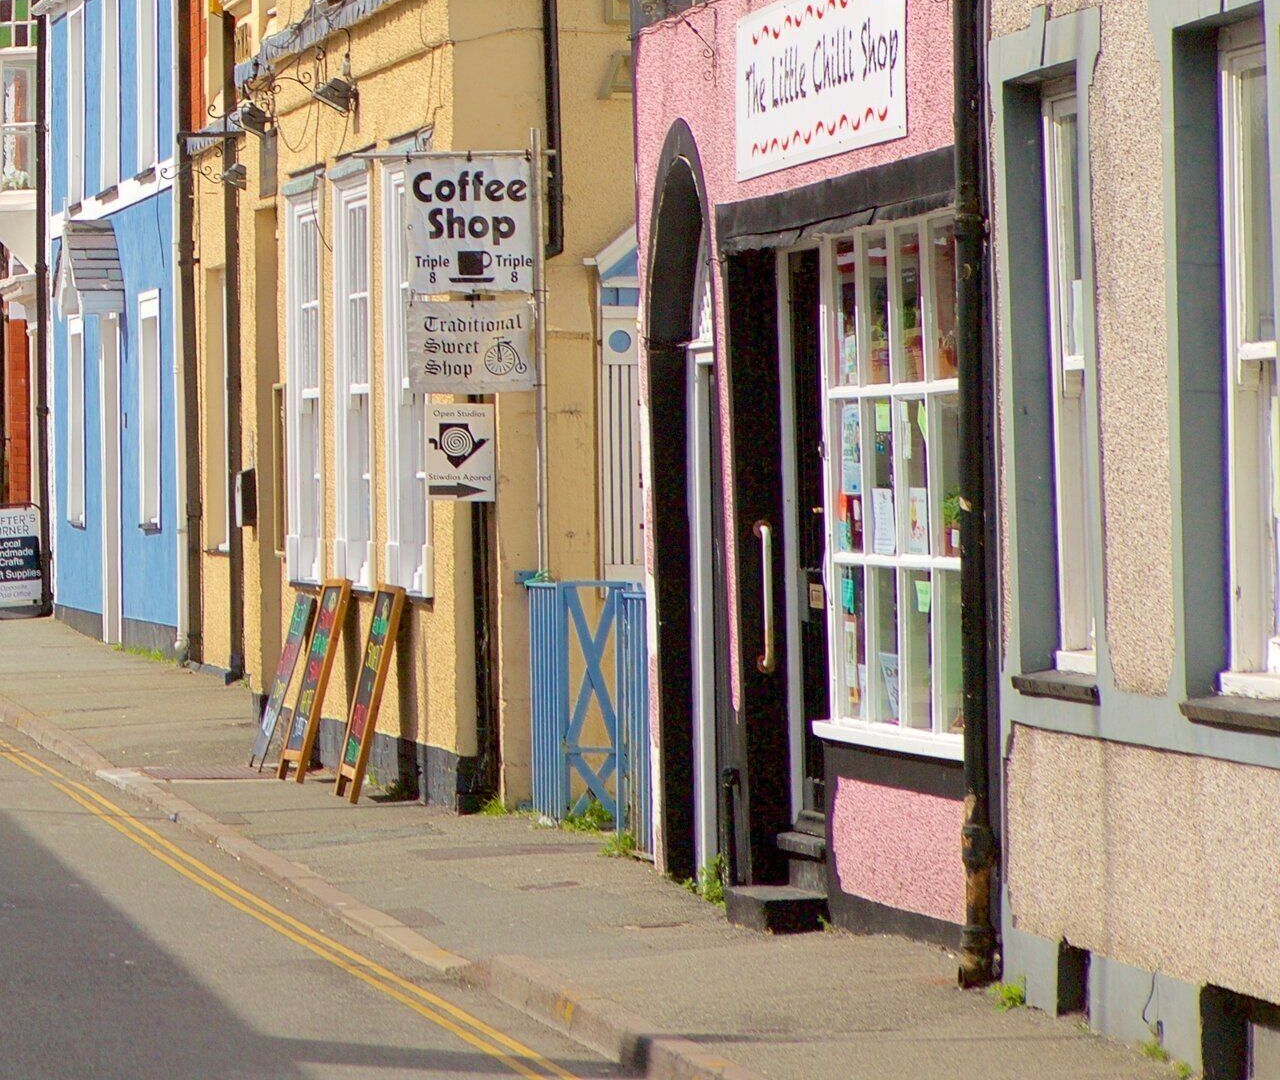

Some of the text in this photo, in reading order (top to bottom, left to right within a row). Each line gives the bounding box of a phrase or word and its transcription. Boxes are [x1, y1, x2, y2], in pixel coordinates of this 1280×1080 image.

[745, 17, 899, 119] The Little Chilli Shop
[412, 171, 527, 202] Coffee
[428, 208, 516, 246] Shop
[415, 254, 450, 270] Triple
[495, 253, 533, 270] Triple
[429, 271, 437, 284] 8
[510, 271, 519, 283] 8
[424, 314, 523, 332] Traditional
[424, 338, 480, 354] Sweet
[424, 359, 473, 379] Shop
[433, 409, 486, 418] Open Studios
[428, 473, 492, 482] Stiwdios Agored
[6, 568, 42, 581] Supplies
